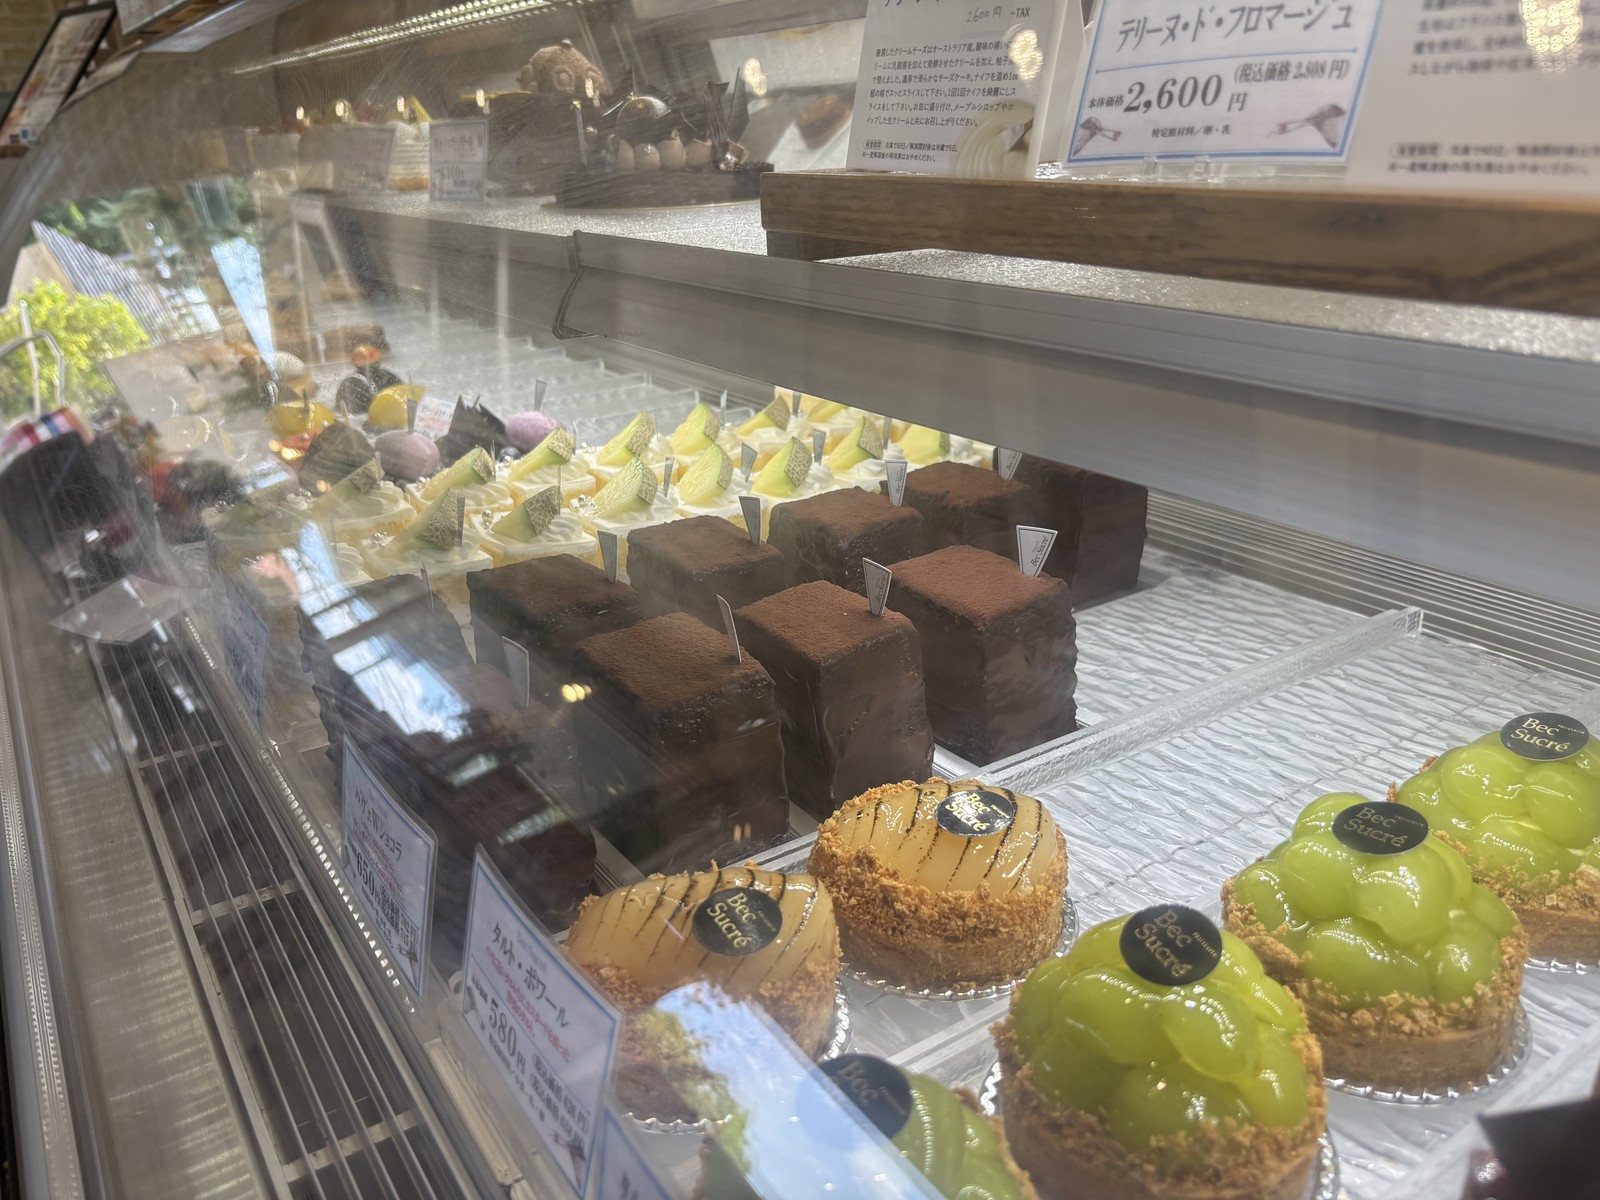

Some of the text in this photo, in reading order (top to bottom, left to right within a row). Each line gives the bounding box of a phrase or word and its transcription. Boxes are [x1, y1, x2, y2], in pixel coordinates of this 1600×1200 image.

[1510, 728, 1570, 752] Sucré
[1522, 717, 1559, 735] Bec
[965, 793, 991, 814] Bec
[1355, 806, 1396, 828] Bec
[1343, 818, 1408, 847] Sucré
[727, 892, 756, 923] Bec
[706, 903, 752, 948] Sucré
[1154, 909, 1192, 948] Bec
[1134, 923, 1192, 977] Sucré
[839, 1062, 878, 1105] Bec
